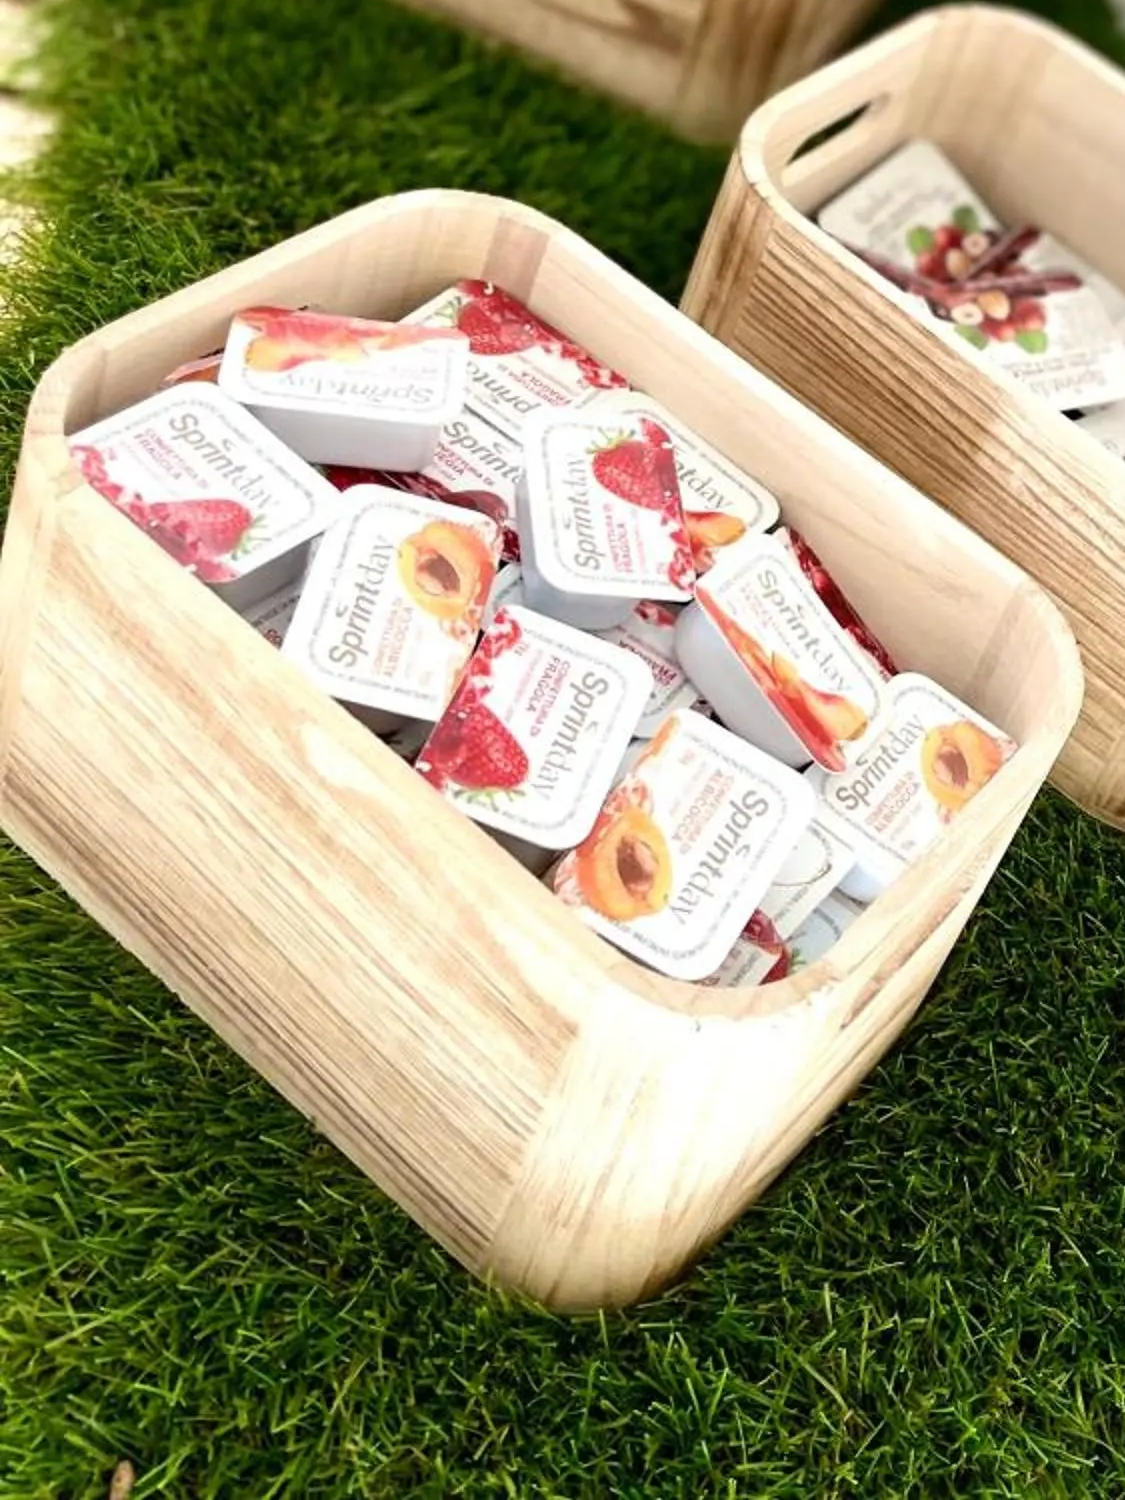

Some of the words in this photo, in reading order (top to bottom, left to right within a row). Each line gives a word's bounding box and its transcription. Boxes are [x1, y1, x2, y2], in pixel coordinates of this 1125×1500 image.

[466, 360, 541, 414] print
[169, 413, 280, 509] Sprintday
[443, 421, 524, 484] Sprint
[563, 453, 606, 570] Sprintday
[328, 534, 394, 668] Sprintday
[757, 569, 852, 691] Sprintday
[526, 654, 561, 713] FRAGOLA
[531, 671, 609, 800] Sprintday
[835, 713, 928, 811] Sprintday
[669, 789, 769, 926] Sprintday
